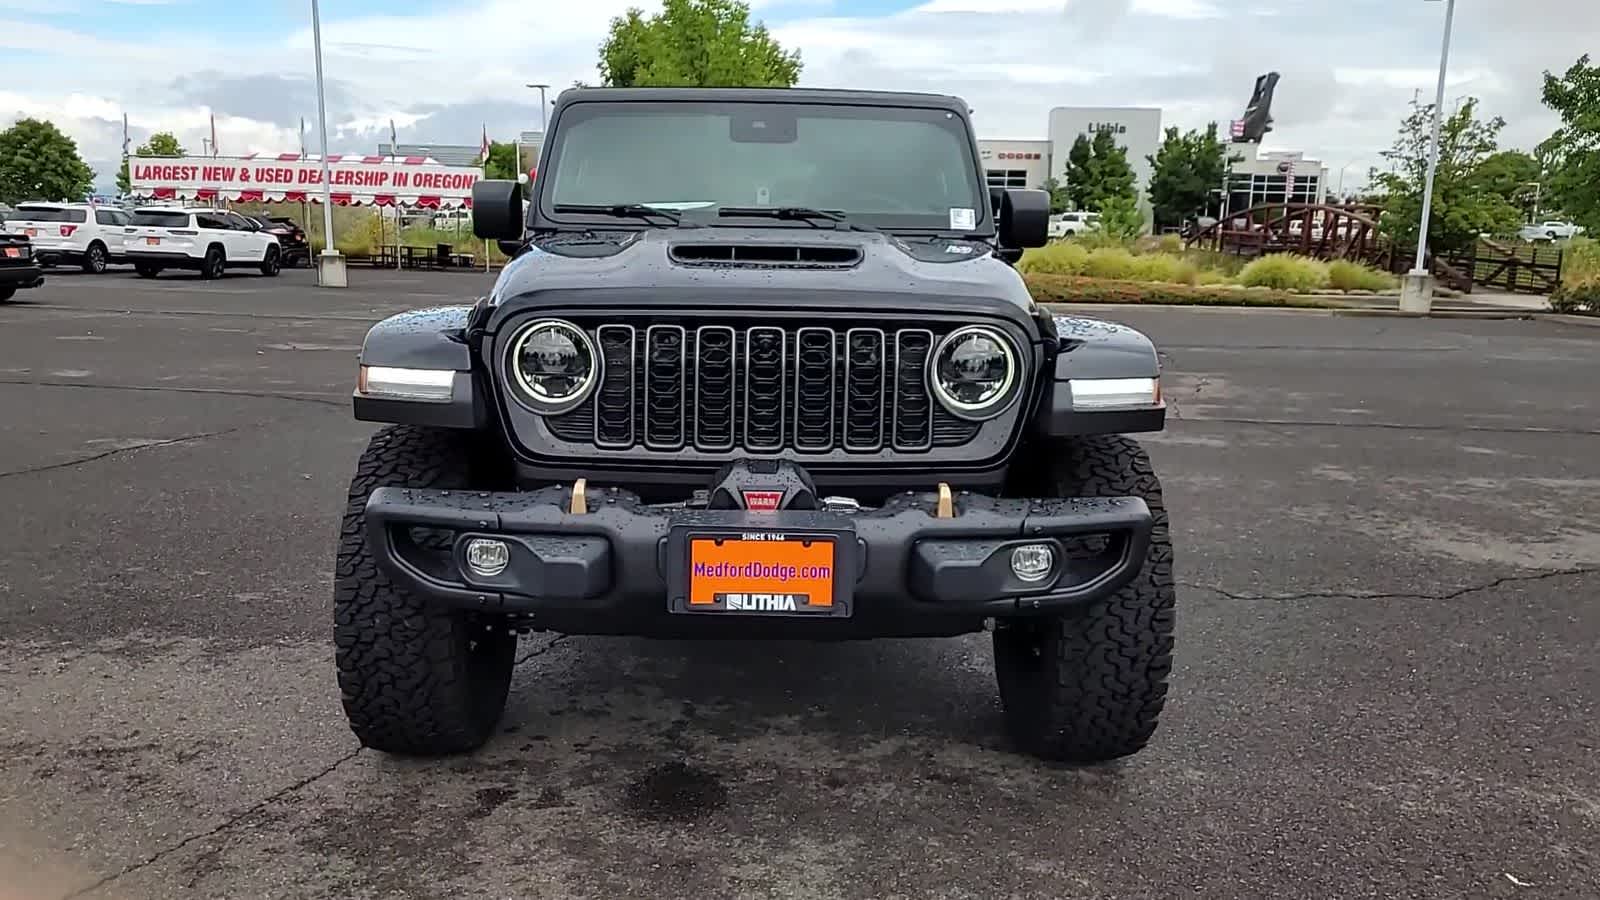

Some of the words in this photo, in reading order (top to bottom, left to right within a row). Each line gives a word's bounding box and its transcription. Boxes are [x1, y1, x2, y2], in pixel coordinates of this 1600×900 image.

[134, 164, 199, 181] LARGEST
[202, 166, 236, 182] NEW
[239, 167, 251, 182] &
[255, 168, 294, 184] USED
[298, 168, 389, 187] DEALERSHIP
[393, 171, 408, 188] IN
[750, 498, 776, 506] WARN
[742, 533, 766, 541] SINCE
[694, 562, 830, 581] MedfordDodge.com
[742, 594, 797, 611] LITHIA
